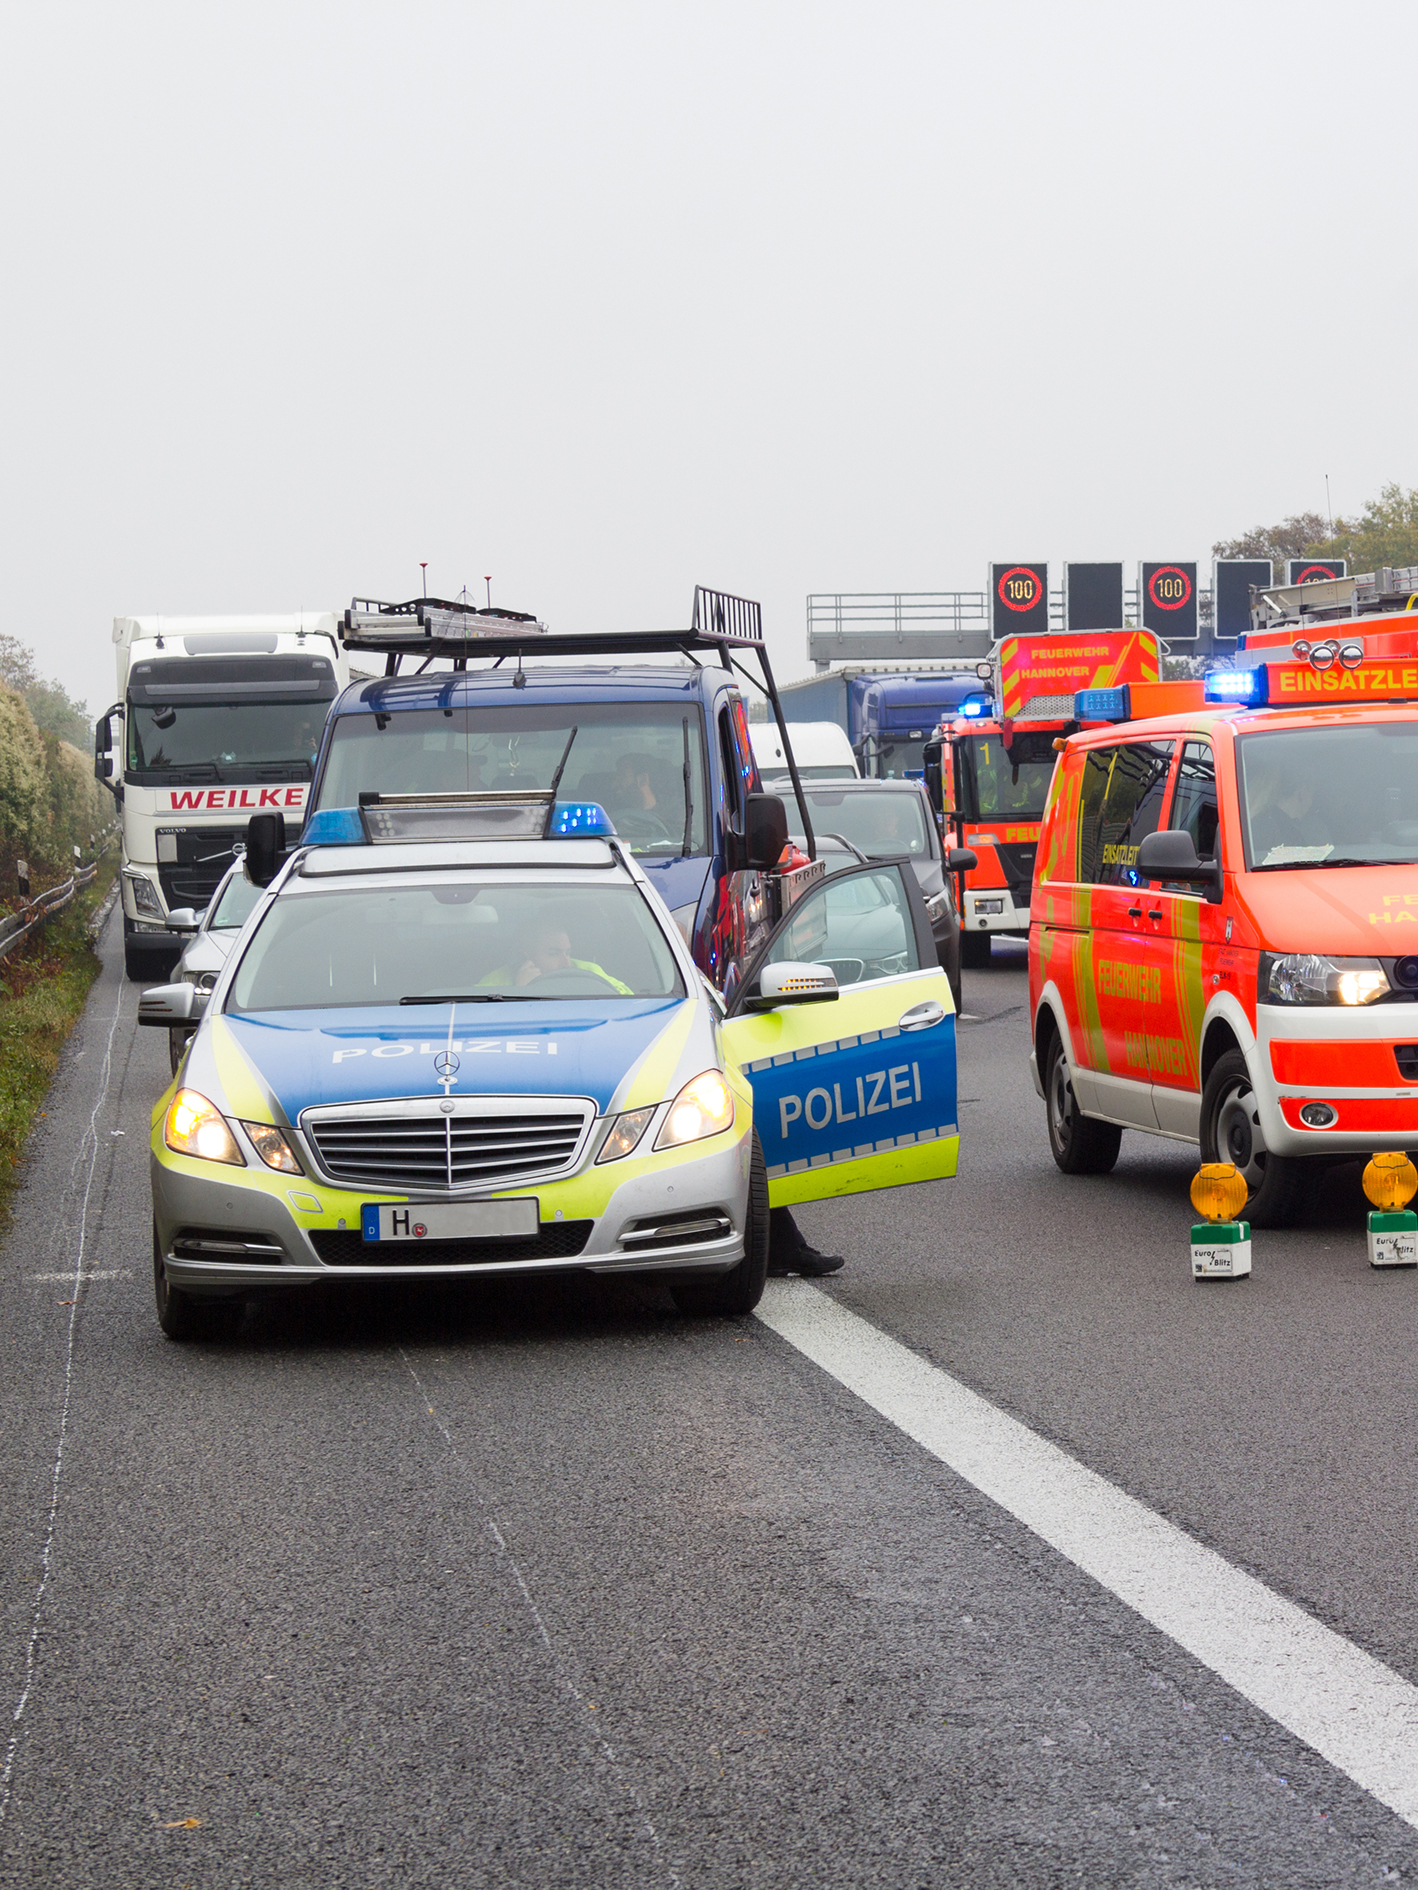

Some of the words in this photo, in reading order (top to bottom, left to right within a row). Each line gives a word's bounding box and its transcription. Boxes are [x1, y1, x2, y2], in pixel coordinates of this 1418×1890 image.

[1007, 580, 1033, 599] 100
[1157, 579, 1183, 598] 100
[1031, 646, 1109, 660] FEUERWEHR
[1021, 666, 1090, 679] HANNOVER
[979, 742, 990, 765] 1
[170, 788, 304, 810] WEILKE
[1098, 959, 1162, 1005] FEUERWEHR
[332, 1040, 558, 1064] POLIZEI
[1124, 1031, 1188, 1076] HANNOVER
[778, 1062, 922, 1138] POLIZEI
[368, 1226, 376, 1235] D
[392, 1209, 410, 1236] H
[1398, 1246, 1414, 1254] litz
